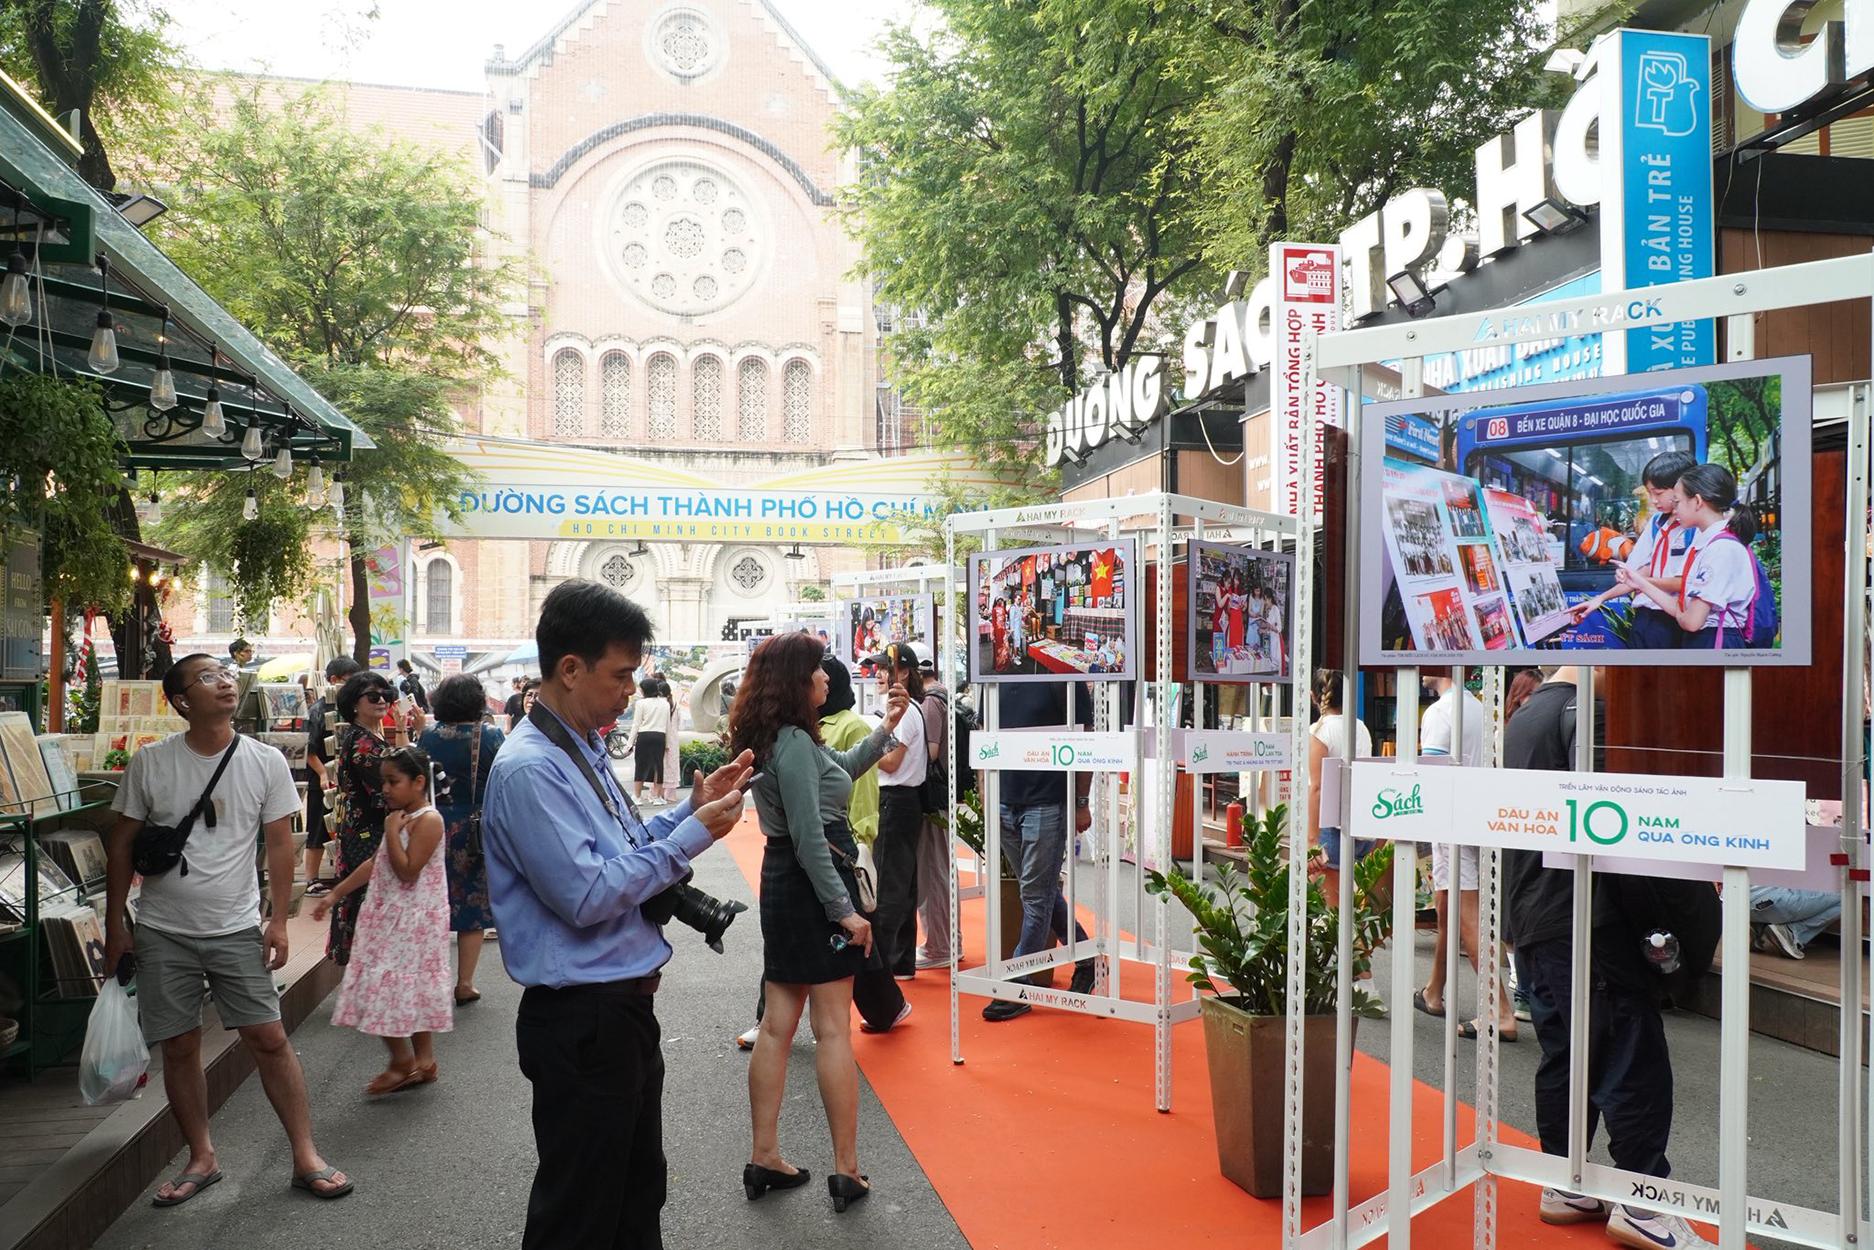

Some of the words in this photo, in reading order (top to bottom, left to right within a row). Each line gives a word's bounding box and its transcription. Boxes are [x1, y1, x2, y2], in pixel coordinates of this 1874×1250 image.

[1641, 153, 1671, 204] TRẺ
[1679, 194, 1694, 249] HOUSE
[1641, 215, 1672, 271] BẢN
[1183, 271, 1271, 400] SÁC
[1340, 188, 1466, 320] TP.
[1286, 309, 1306, 342] HỢP
[1592, 297, 1663, 328] RACK
[1283, 347, 1300, 393] TỔNG
[1553, 343, 1601, 373] HOUSE
[1489, 419, 1507, 437] 08
[1517, 414, 1534, 433] BẾN
[1535, 418, 1546, 431] XE
[1547, 413, 1571, 432] QUẬN
[1571, 415, 1578, 427] 8
[1584, 411, 1599, 430] ĐẠI
[1600, 409, 1620, 426] HỌC
[1621, 401, 1648, 421] QUỐC
[1649, 403, 1665, 418] GIA
[458, 488, 566, 514] ĐƯỜNG
[574, 490, 649, 516] SÁCH
[657, 492, 752, 518] THÀNH
[762, 494, 817, 519] PHỐ
[826, 495, 865, 520] HỒ
[872, 497, 915, 521] CHÍ
[573, 523, 593, 534] HO
[608, 523, 638, 535] CHI
[653, 524, 697, 536] MINH
[711, 525, 751, 537] CITY
[766, 526, 810, 538] BOOK
[823, 527, 887, 539] STREET
[11, 571, 32, 591] HELLO
[14, 597, 28, 608] FROM
[6, 619, 33, 638] SAIGON
[979, 742, 999, 761] Sách
[1051, 744, 1075, 766] 10
[1192, 743, 1208, 763] Sách
[1253, 740, 1266, 757] 10
[1372, 783, 1424, 819] Sách
[1634, 786, 1654, 795] SÁNG
[1656, 787, 1669, 795] TÁC
[1565, 799, 1629, 846] 10
[1637, 831, 1675, 844] QUA
[1028, 991, 1044, 1002] HAI
[1046, 994, 1059, 1004] MY
[1061, 996, 1087, 1010] RACK
